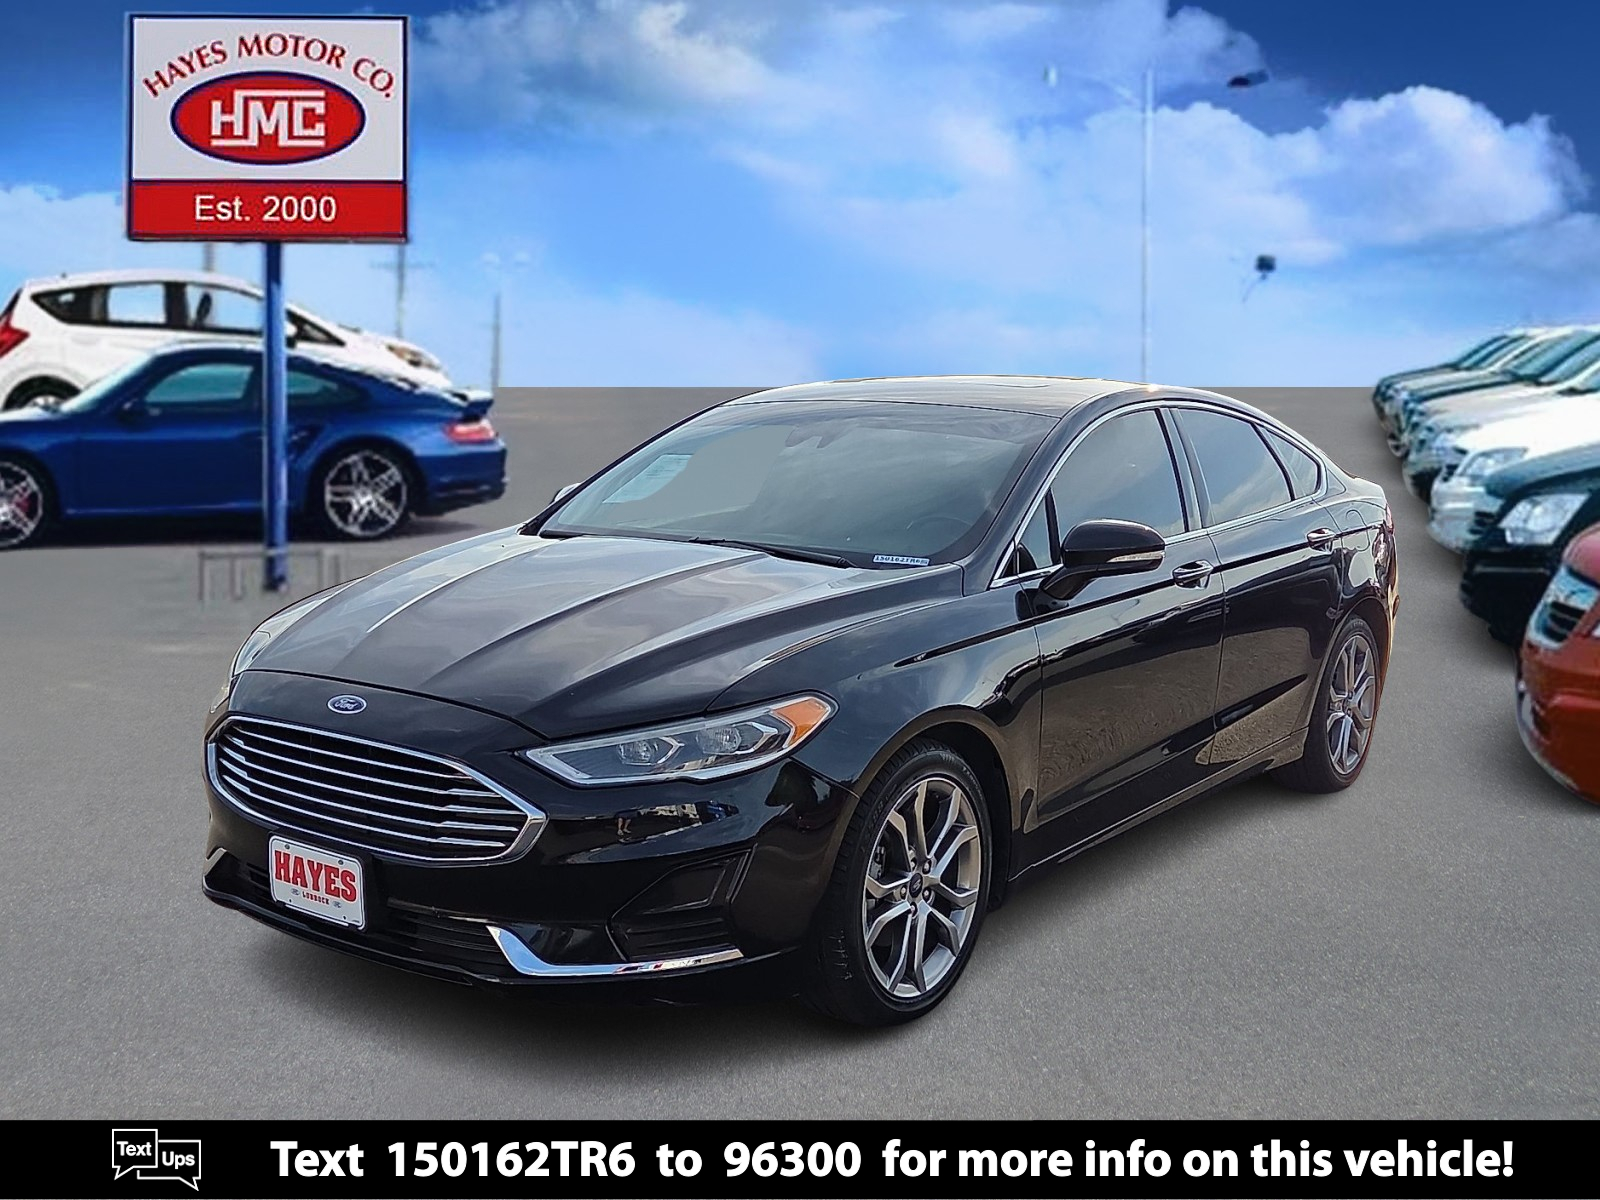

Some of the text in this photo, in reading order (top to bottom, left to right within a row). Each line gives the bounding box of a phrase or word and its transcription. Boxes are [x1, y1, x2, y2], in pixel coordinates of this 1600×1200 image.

[143, 33, 394, 98] HAYES MOTOR CO.
[210, 89, 326, 147] HMC
[194, 194, 336, 222] Est. 2000
[274, 849, 357, 903] HAYES
